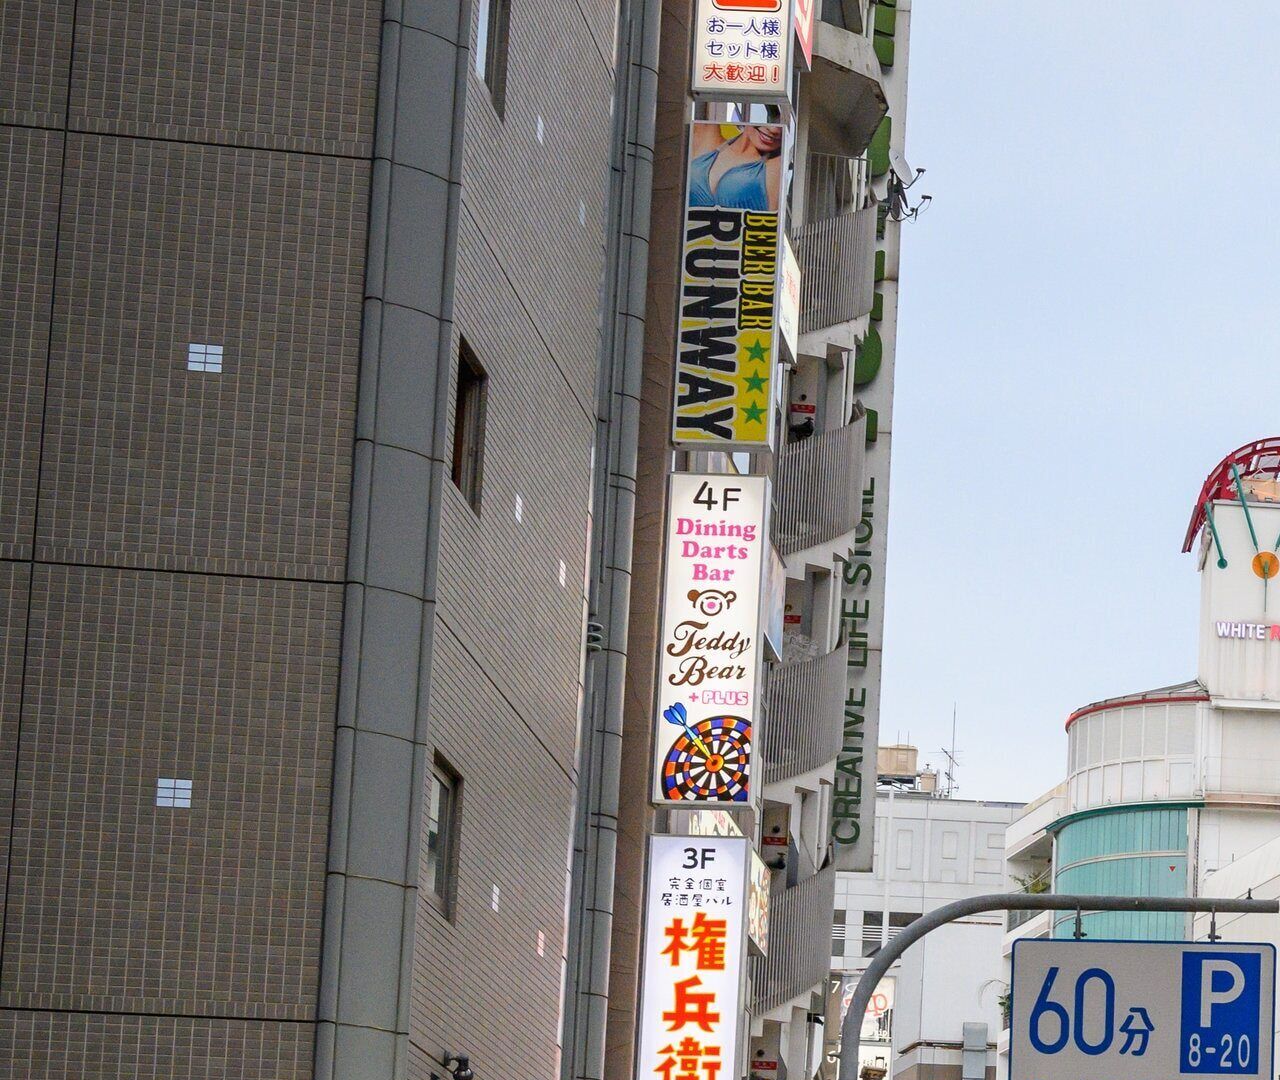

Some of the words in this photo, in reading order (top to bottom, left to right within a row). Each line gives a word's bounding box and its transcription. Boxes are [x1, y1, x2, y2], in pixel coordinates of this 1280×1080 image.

[706, 17, 781, 36] お一人様
[706, 40, 779, 60] セット様
[741, 210, 780, 275] BEER
[738, 280, 776, 332] BAR
[675, 206, 742, 440] RUNWAY
[693, 480, 741, 511] 4F
[676, 518, 756, 542] Dining
[682, 540, 748, 560] Darts
[692, 563, 734, 582] Bar
[667, 620, 751, 659] Teddy
[1216, 621, 1266, 640] WHITE
[667, 656, 747, 687] Bear
[702, 690, 749, 706] PLUS
[682, 847, 715, 870] 3F
[668, 878, 728, 892] 完全個室
[1200, 959, 1246, 1028] P
[1029, 966, 1155, 1056] 60分
[1188, 1033, 1251, 1068] 8-20
